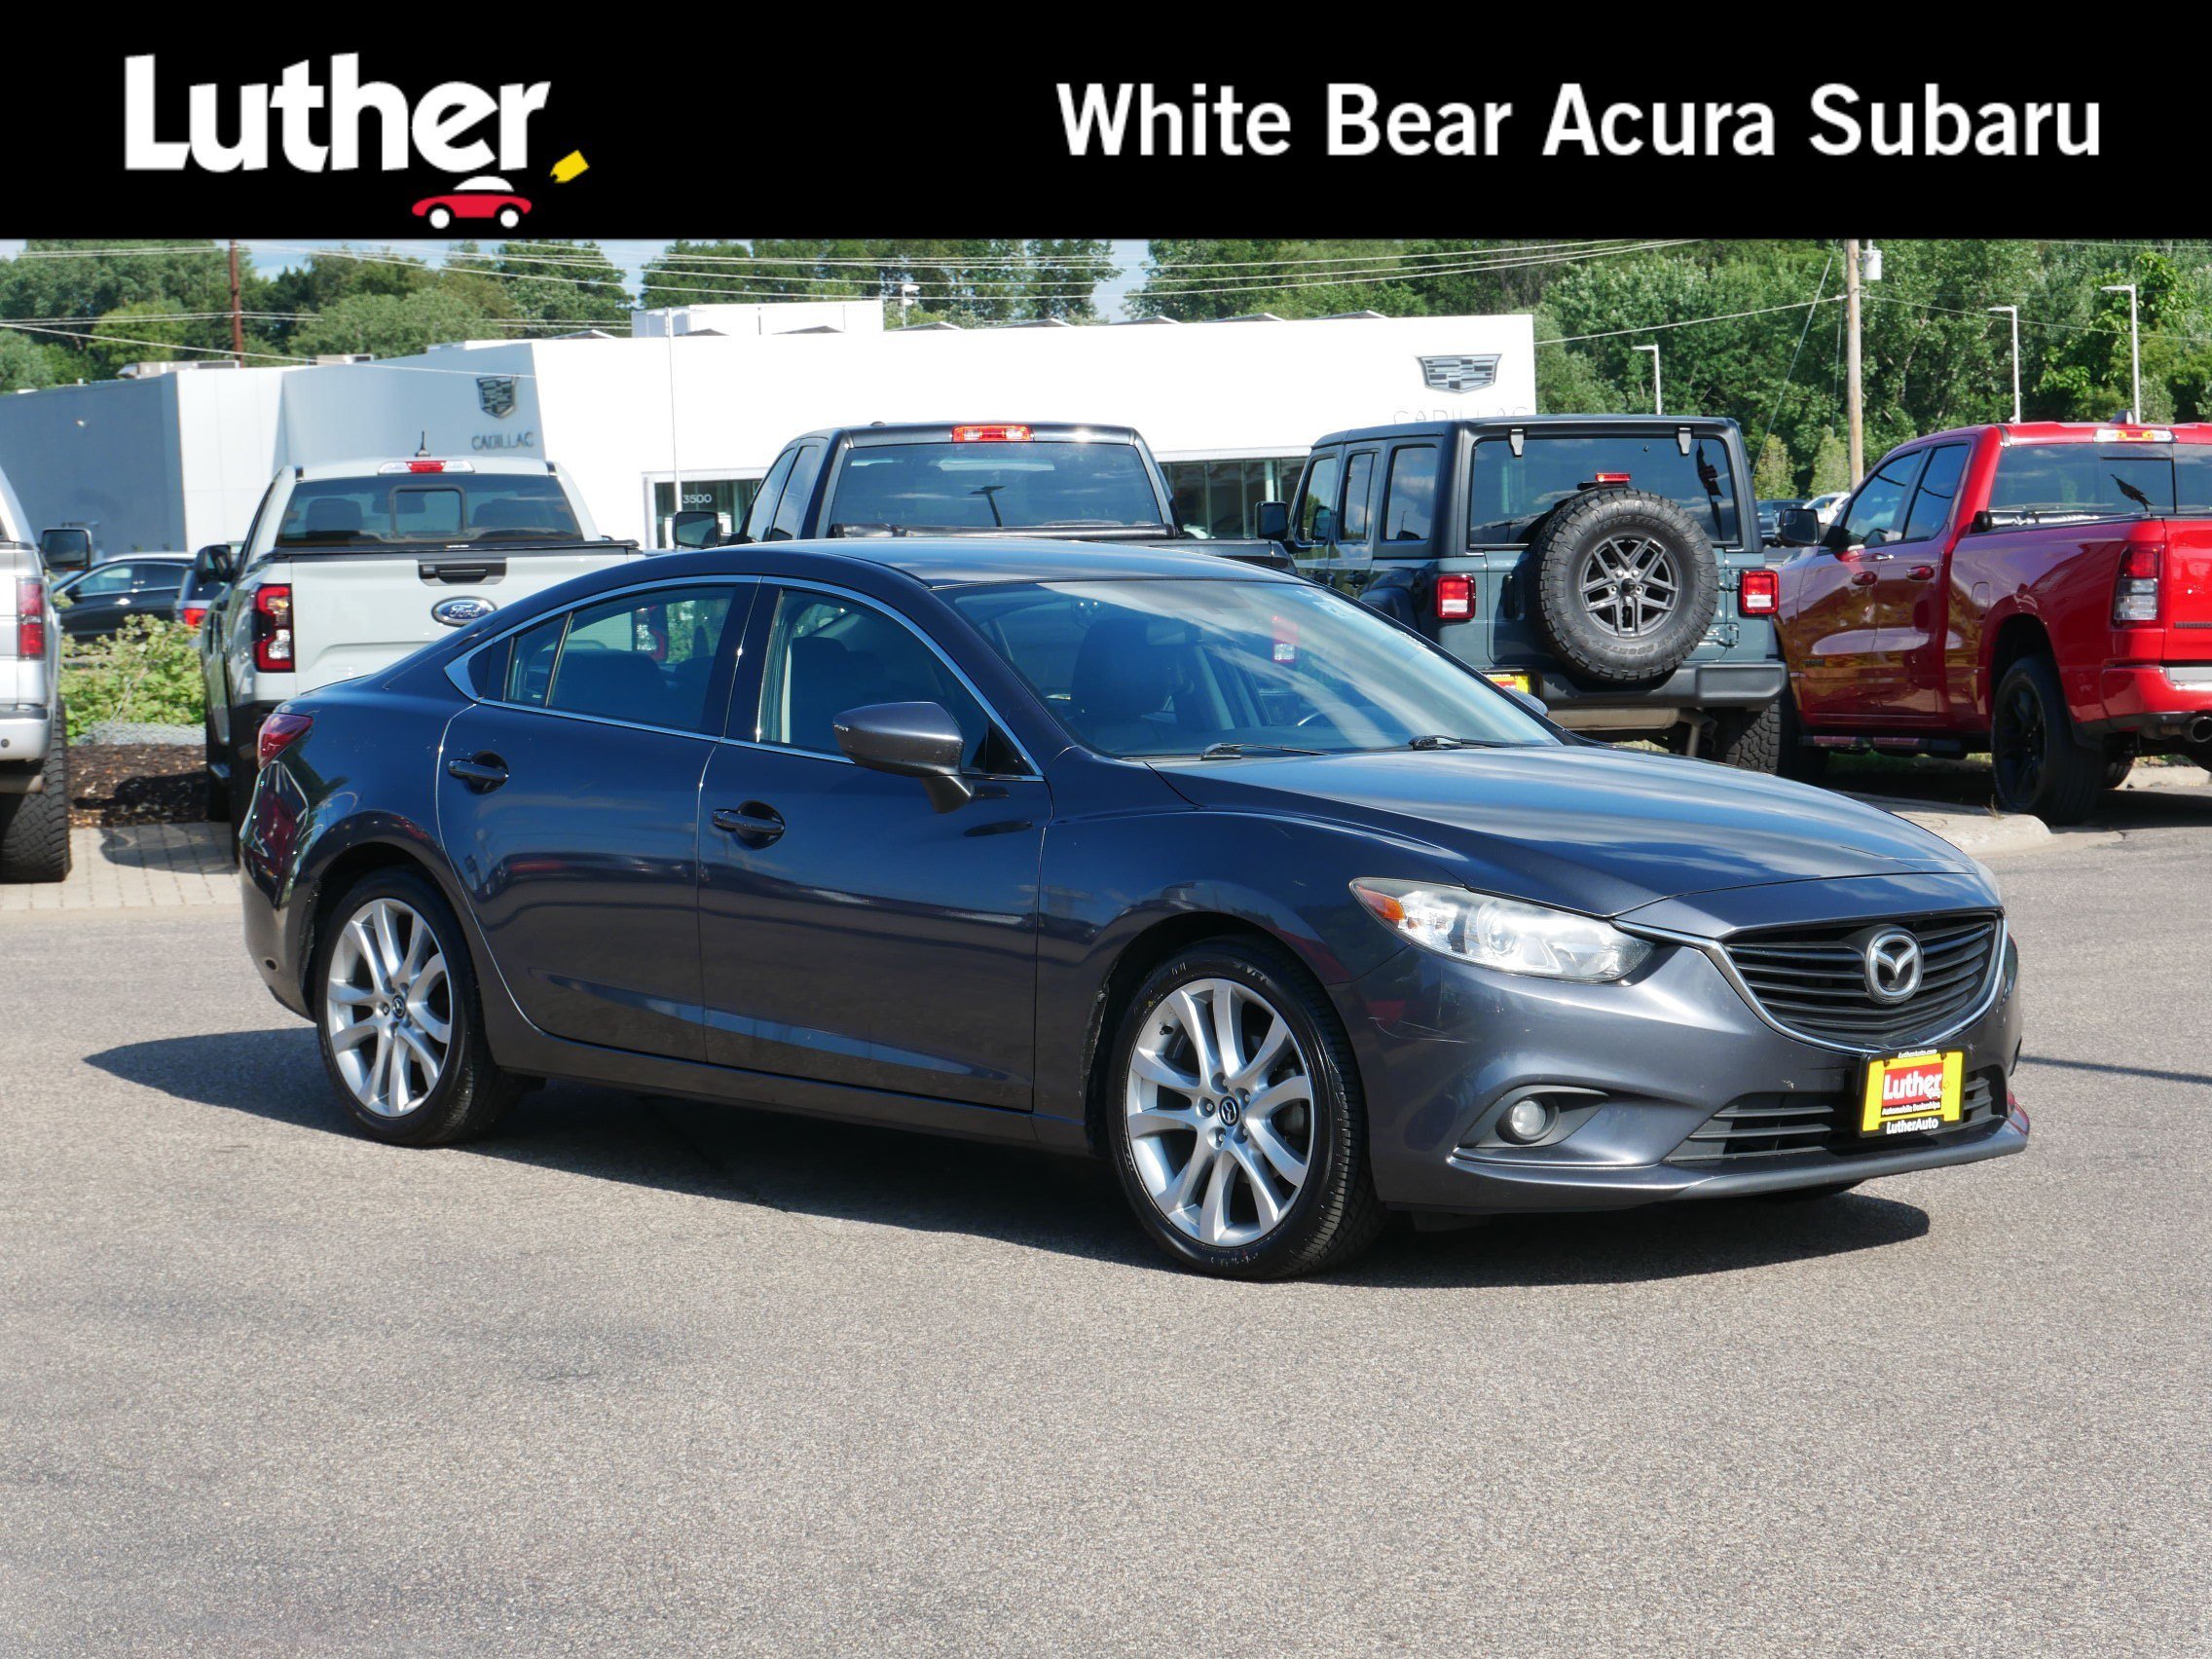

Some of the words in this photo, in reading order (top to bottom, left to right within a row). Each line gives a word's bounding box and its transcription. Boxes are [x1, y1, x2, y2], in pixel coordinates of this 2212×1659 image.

[471, 431, 534, 451] CADILLAC
[682, 494, 713, 503] 3500
[1883, 1071, 1942, 1099] Luther
[1882, 1104, 1913, 1116] Automobile
[1886, 1118, 1938, 1134] LutherAuto
